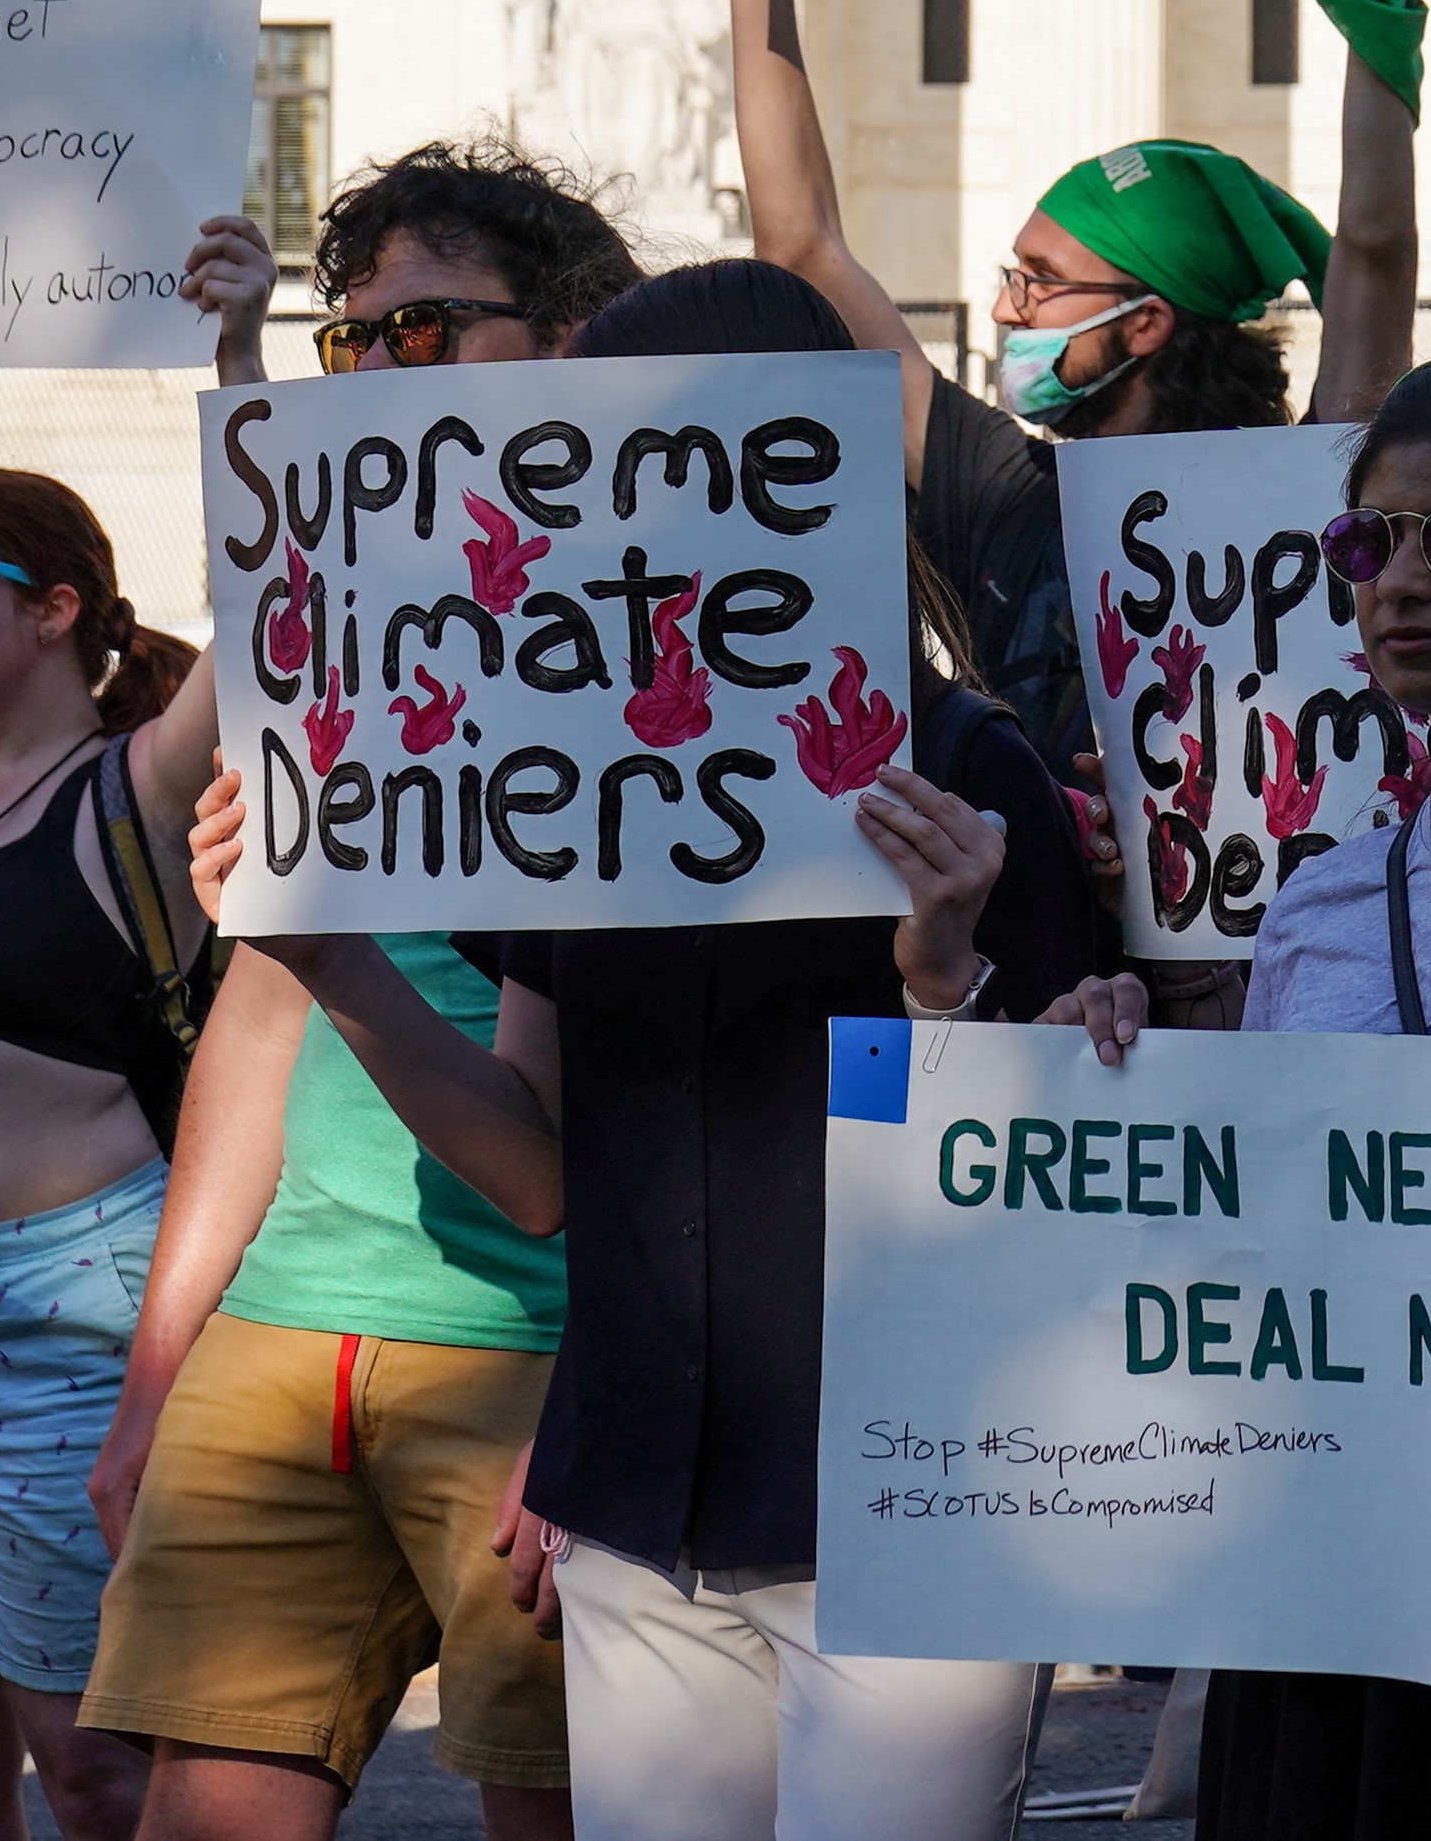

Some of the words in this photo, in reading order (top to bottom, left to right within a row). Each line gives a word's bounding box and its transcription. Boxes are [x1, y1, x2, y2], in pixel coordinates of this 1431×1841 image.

[46, 251, 206, 325] autono
[224, 398, 841, 571] Supreme
[252, 546, 814, 704] Climate
[1132, 663, 1421, 801] Clim
[261, 719, 775, 883] Deniers
[939, 1118, 1241, 1218] GREEN
[1124, 1282, 1365, 1385] DEAL
[861, 1421, 966, 1476] Stop
